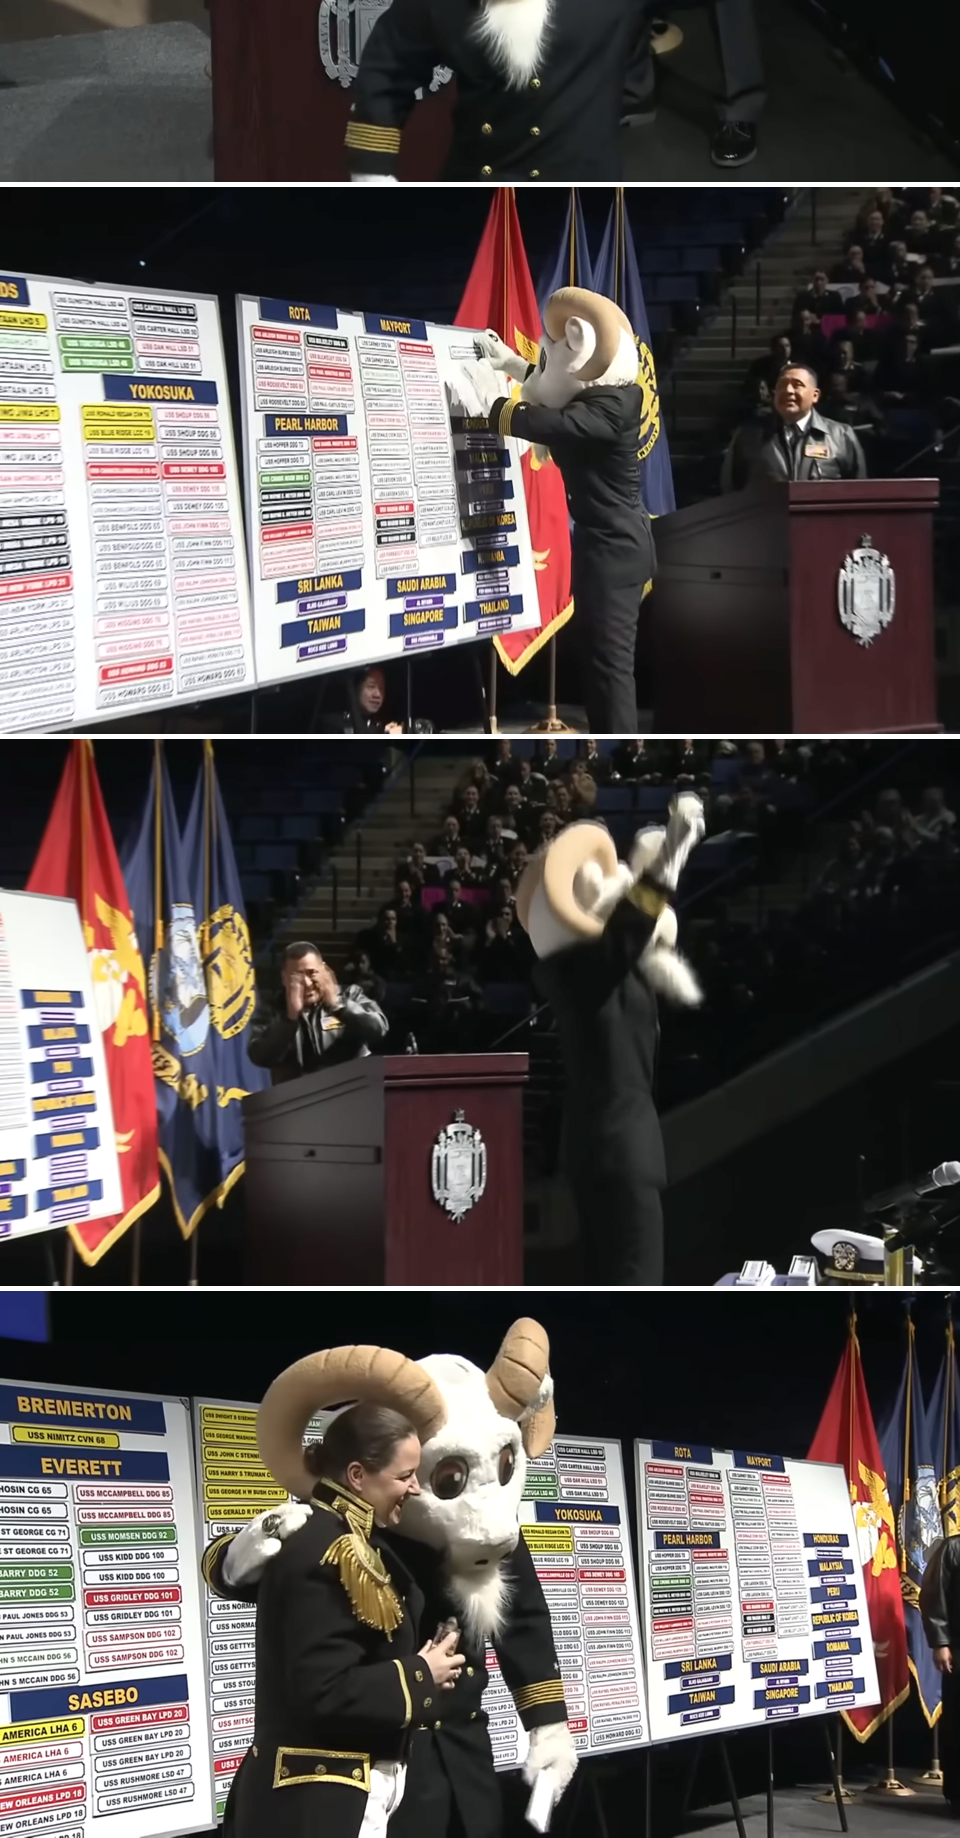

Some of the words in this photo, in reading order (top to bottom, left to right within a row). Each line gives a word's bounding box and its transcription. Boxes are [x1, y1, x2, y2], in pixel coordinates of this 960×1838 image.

[288, 306, 311, 321] ROTA
[380, 319, 411, 334] MAYPORT
[129, 384, 195, 400] YOKOSUKA
[275, 417, 302, 431] PEARL
[304, 417, 339, 431] HARBOR
[297, 580, 313, 594] SRI
[314, 574, 344, 591] LANKA
[307, 615, 341, 634] TAIWAN
[17, 1396, 132, 1421] BREMERTON
[28, 1431, 44, 1440] USS
[47, 1433, 75, 1442] NIMITZ
[41, 1457, 122, 1476] EVERETT
[554, 1508, 602, 1522] YOKOSUKA
[663, 1534, 685, 1545] PEARL
[686, 1534, 713, 1545] HARBOR
[681, 1661, 693, 1672] SRI
[694, 1657, 717, 1670] LANKA
[760, 1663, 777, 1673] SAUDI
[778, 1662, 800, 1673] ARABIA
[765, 1688, 798, 1700] SINGAPORE
[828, 1681, 853, 1692] THAILAND
[68, 1687, 139, 1711] SASEBO
[689, 1691, 715, 1704] TAIWAN
[98, 1718, 113, 1726] USS
[115, 1715, 140, 1724] GREEN
[142, 1713, 157, 1721] BAY
[159, 1711, 172, 1719] LPD
